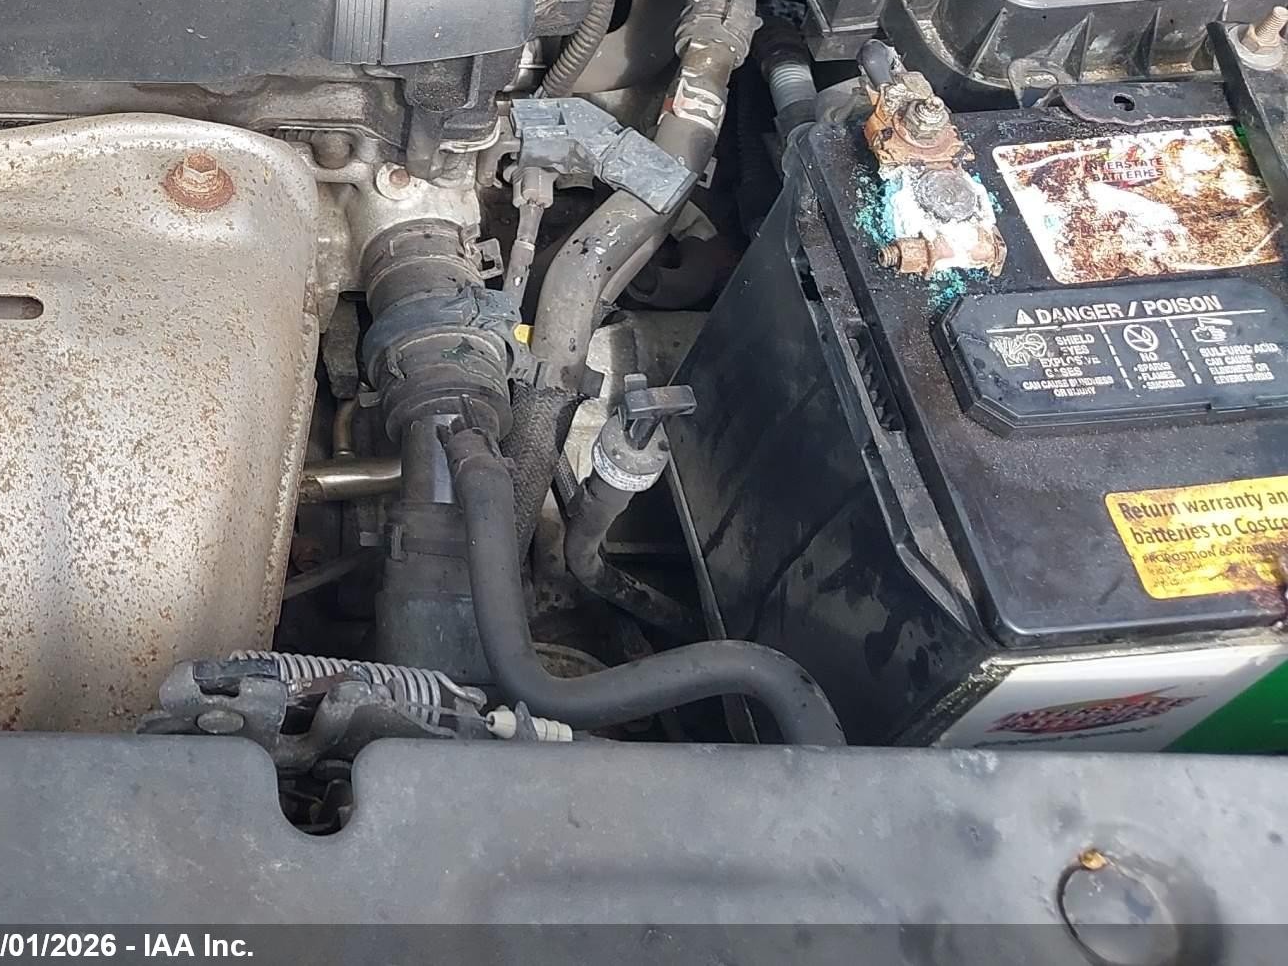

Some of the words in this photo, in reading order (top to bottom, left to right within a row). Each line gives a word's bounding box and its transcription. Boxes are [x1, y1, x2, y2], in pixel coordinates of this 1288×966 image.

[1092, 168, 1164, 182] BATTERIES
[1034, 302, 1125, 324] DANGER
[1142, 295, 1224, 316] POISON
[1054, 333, 1095, 346] SHIELD
[1139, 351, 1159, 362] NO
[1199, 344, 1253, 357] SULFURIC
[1117, 499, 1181, 521] Return
[1182, 491, 1263, 513] warranty
[1266, 490, 1288, 505] an
[1129, 522, 1210, 545] batteries
[1212, 520, 1232, 537] to
[1234, 515, 1288, 535] Costco
